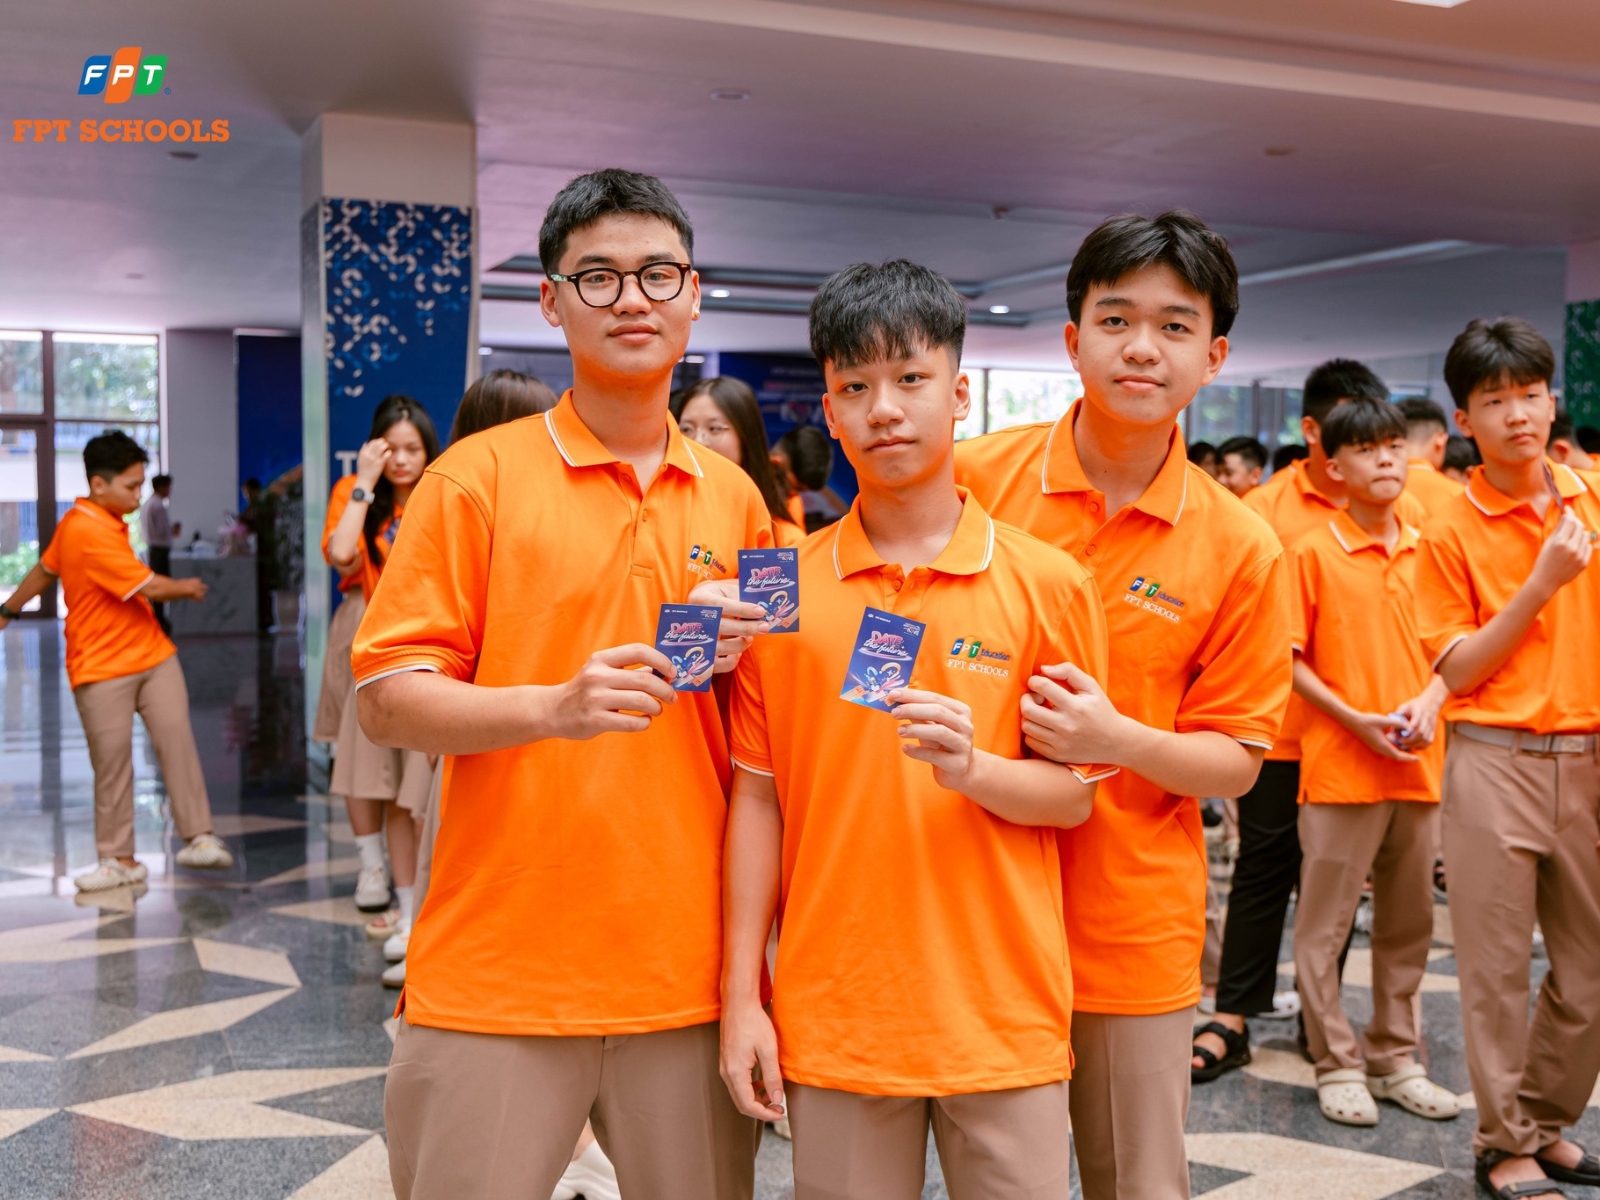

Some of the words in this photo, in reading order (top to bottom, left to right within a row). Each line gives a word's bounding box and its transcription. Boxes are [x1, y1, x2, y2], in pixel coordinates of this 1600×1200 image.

[1123, 592, 1143, 607] FPT
[1142, 600, 1180, 623] SCHOOLS
[670, 622, 703, 635] DATE
[870, 630, 904, 648] DATE
[946, 658, 967, 670] FPT
[968, 661, 1009, 678] SCHOOLS
